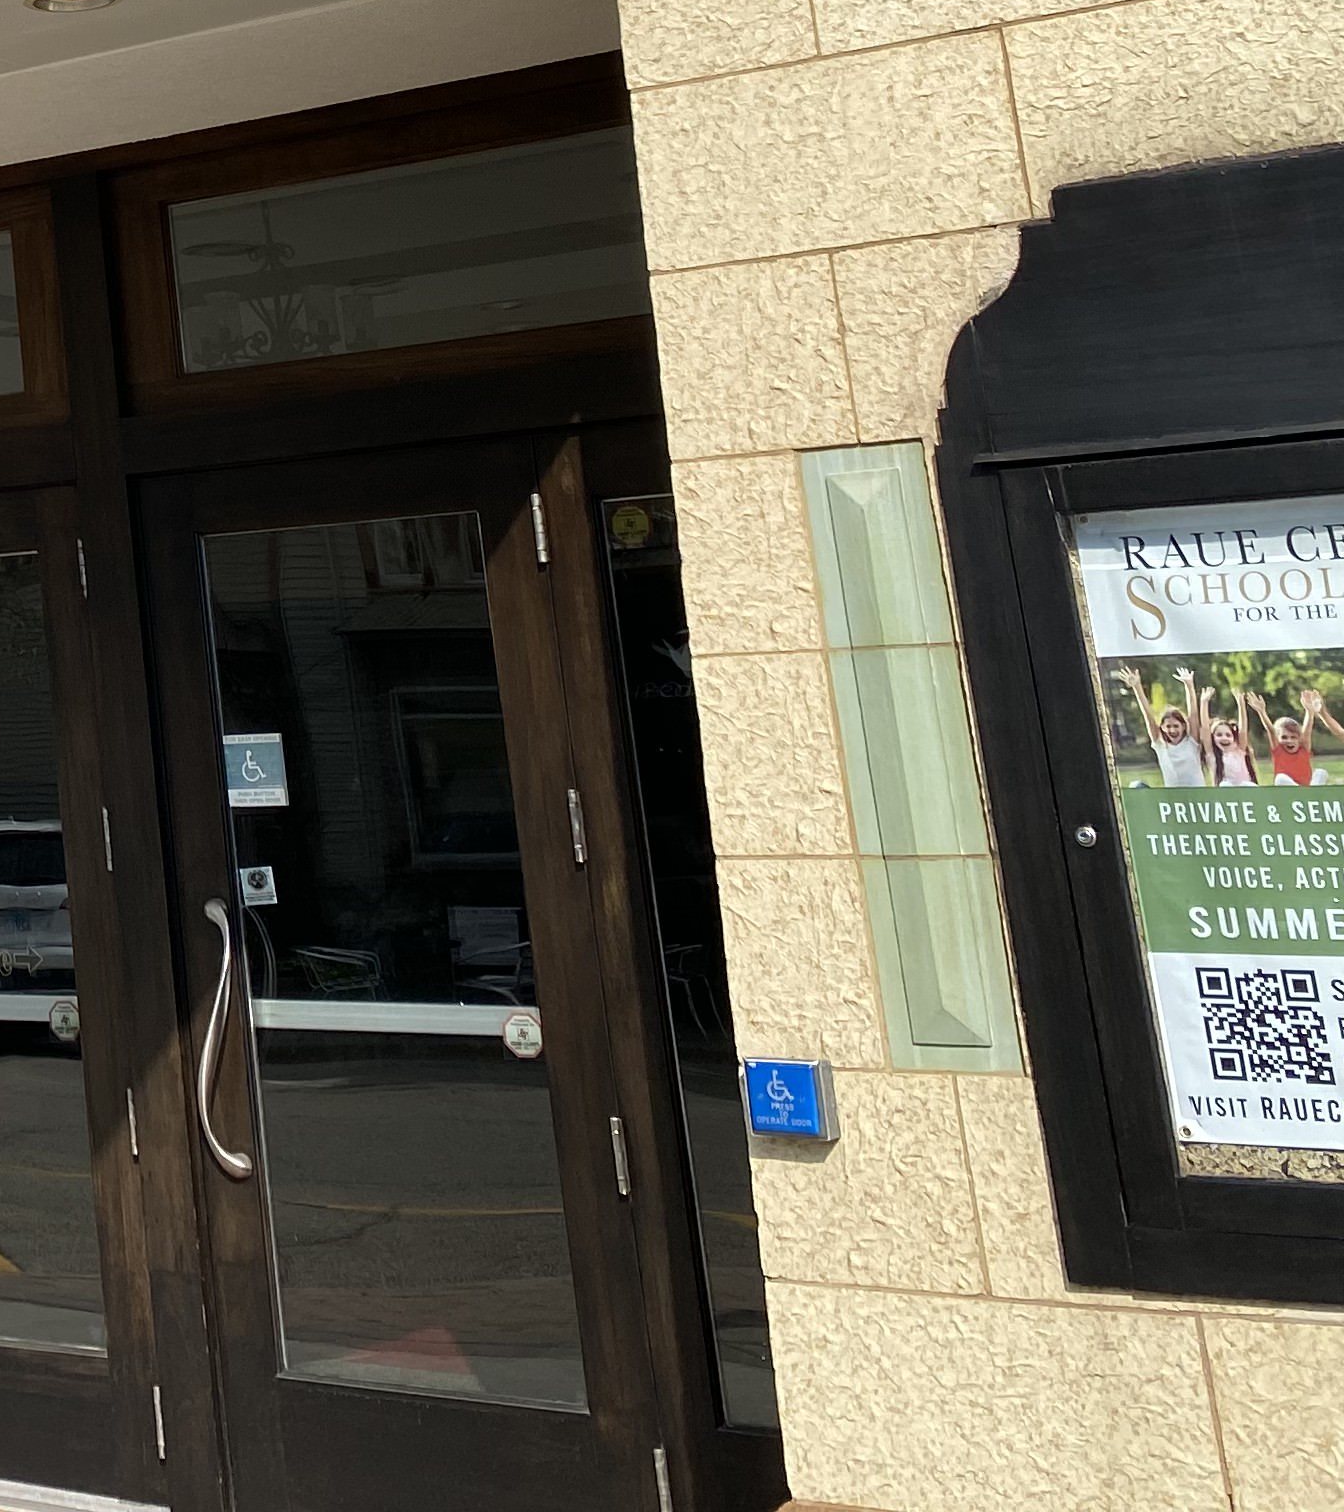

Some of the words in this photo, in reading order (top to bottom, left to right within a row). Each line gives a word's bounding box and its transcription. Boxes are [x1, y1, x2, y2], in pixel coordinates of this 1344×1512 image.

[1118, 528, 1266, 571] RAUE
[1126, 567, 1344, 641] SCHOOL
[1233, 606, 1280, 623] FOR
[1288, 603, 1338, 621] THE
[1159, 801, 1257, 823] PRIVATE
[1266, 804, 1282, 823] &
[1292, 801, 1343, 823] SEM
[1146, 833, 1251, 856] THEATRE
[1203, 866, 1284, 891] VOICE,
[1188, 905, 1344, 941] SUMME
[1188, 1096, 1248, 1118] VISIT
[1260, 1096, 1342, 1123] RAUEC
